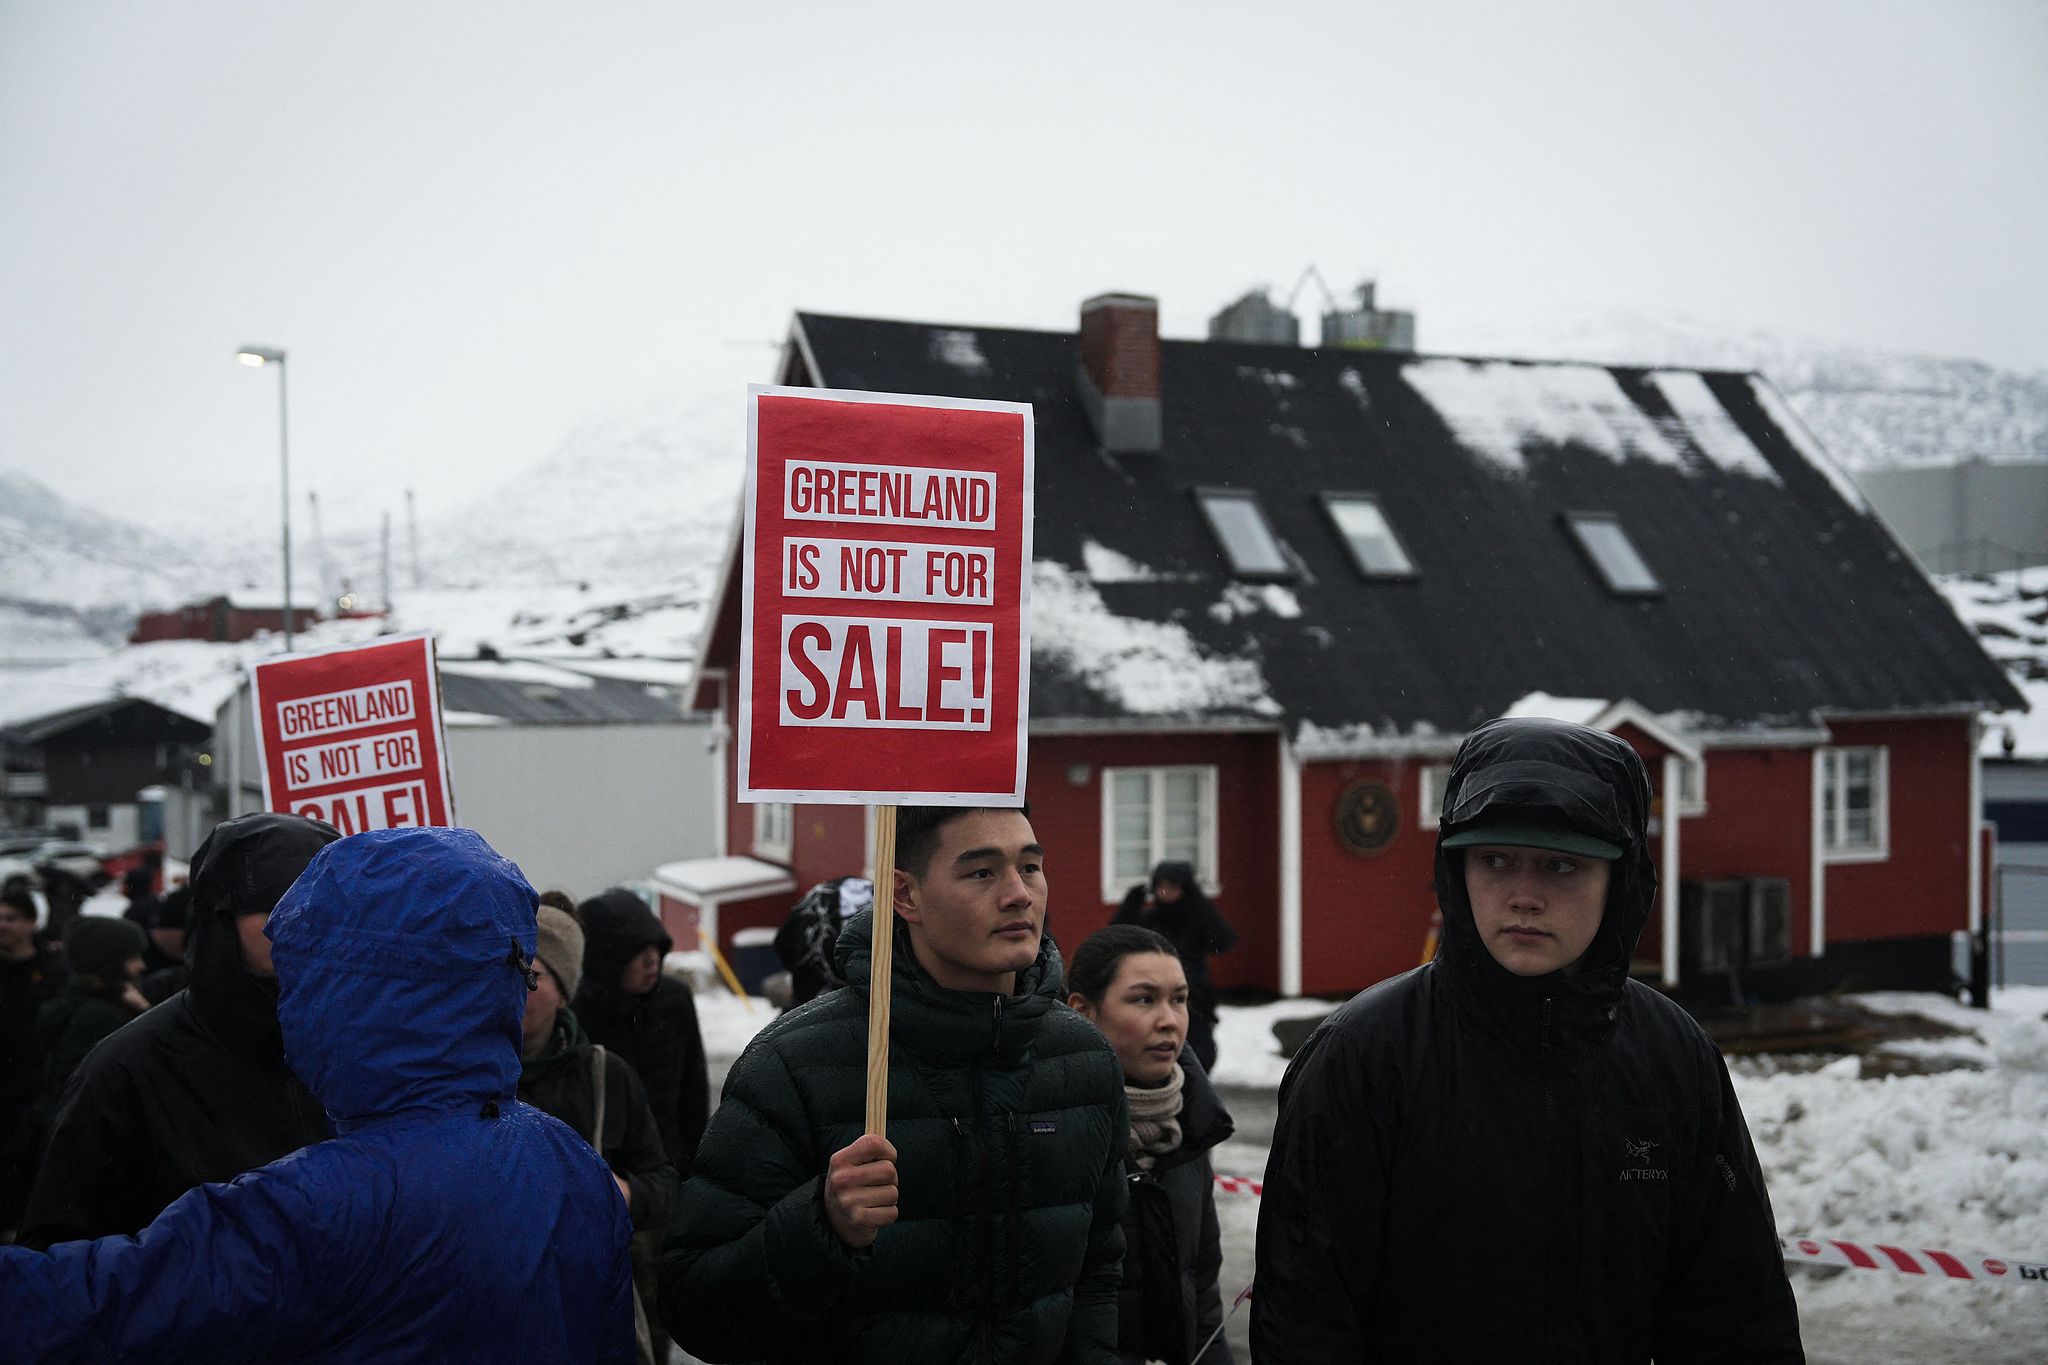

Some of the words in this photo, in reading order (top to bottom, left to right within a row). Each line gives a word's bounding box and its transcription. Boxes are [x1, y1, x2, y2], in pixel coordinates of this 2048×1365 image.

[790, 467, 991, 523] GREENLAND
[789, 544, 821, 590] IS
[840, 546, 908, 594] NOT
[926, 551, 988, 598] FOR
[786, 622, 987, 723] SALE!
[283, 687, 410, 735] GREENLAND
[289, 754, 310, 785] IS
[320, 744, 361, 780] NOT
[374, 736, 417, 770] FOR
[298, 785, 426, 836] ALE!
